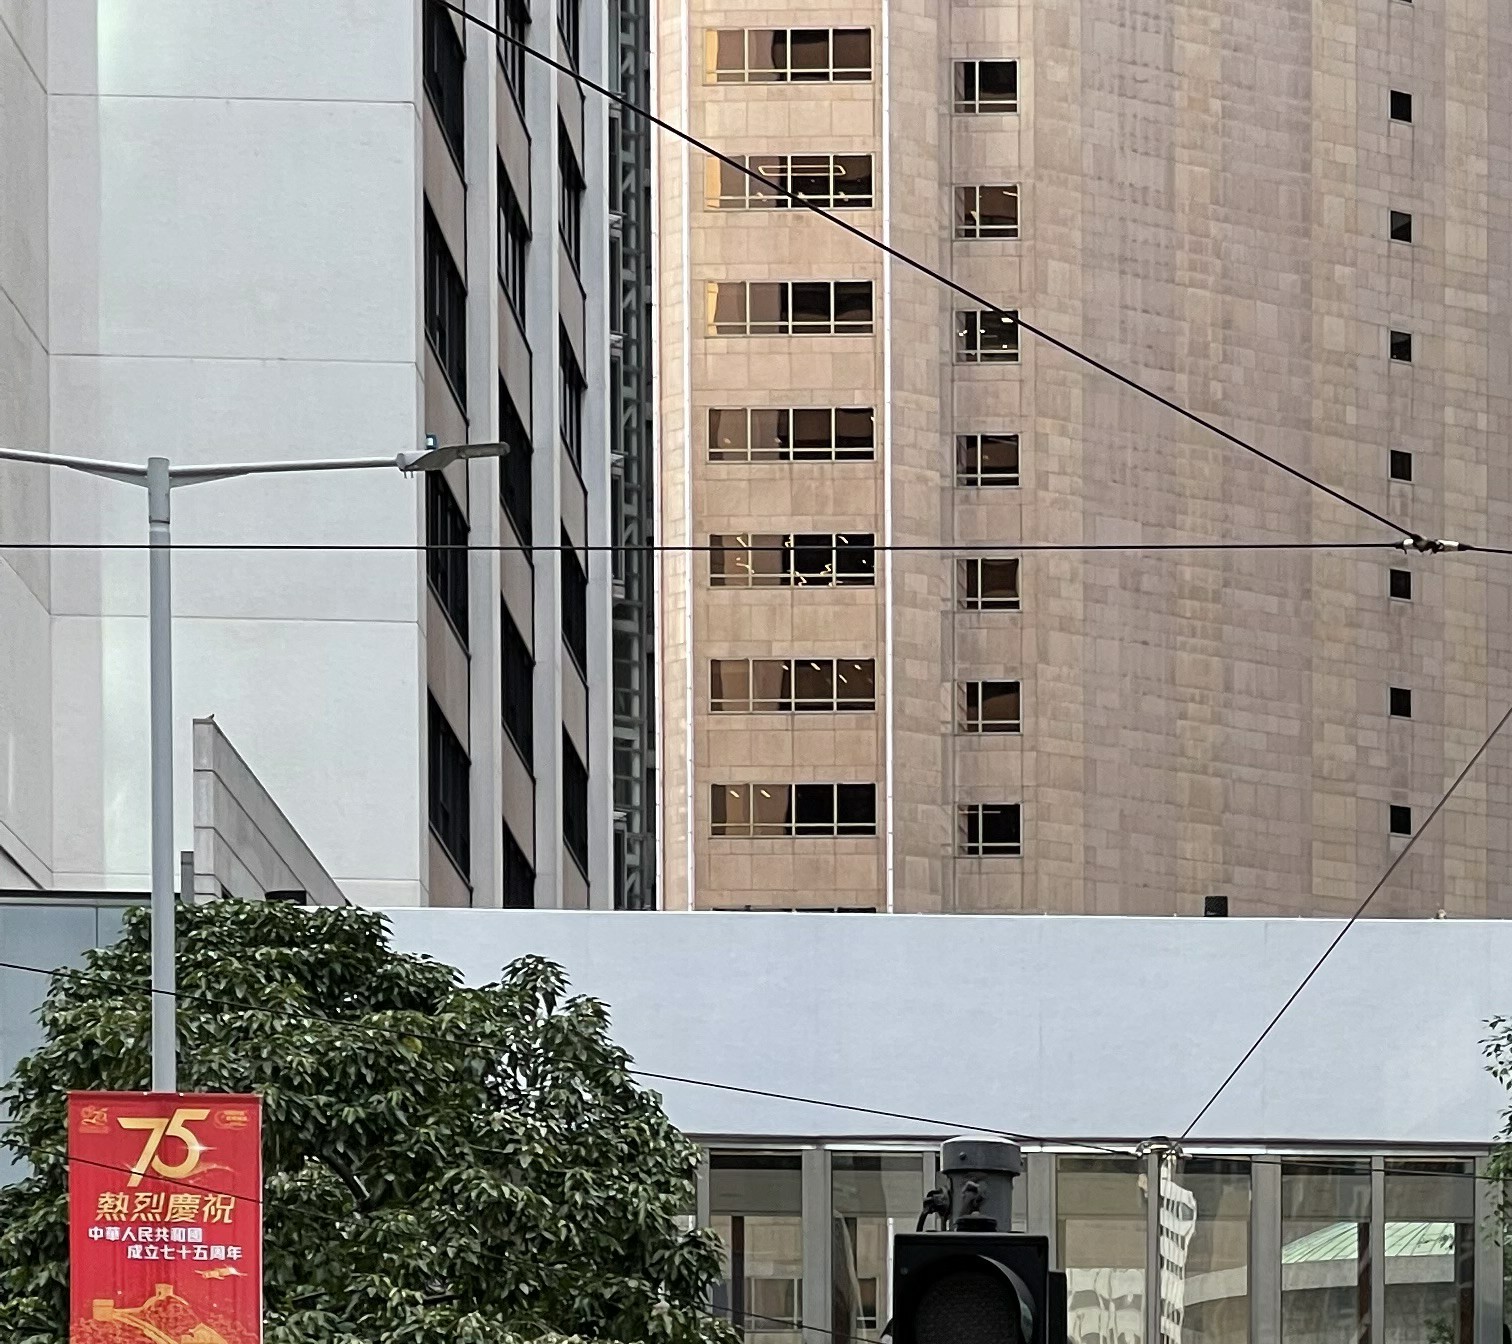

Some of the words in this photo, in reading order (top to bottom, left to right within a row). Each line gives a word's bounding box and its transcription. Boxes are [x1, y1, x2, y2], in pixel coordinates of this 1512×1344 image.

[117, 1108, 211, 1187] 75
[95, 1191, 236, 1224] 熱烈慶祝
[127, 1244, 242, 1261] 成立七十五周年
